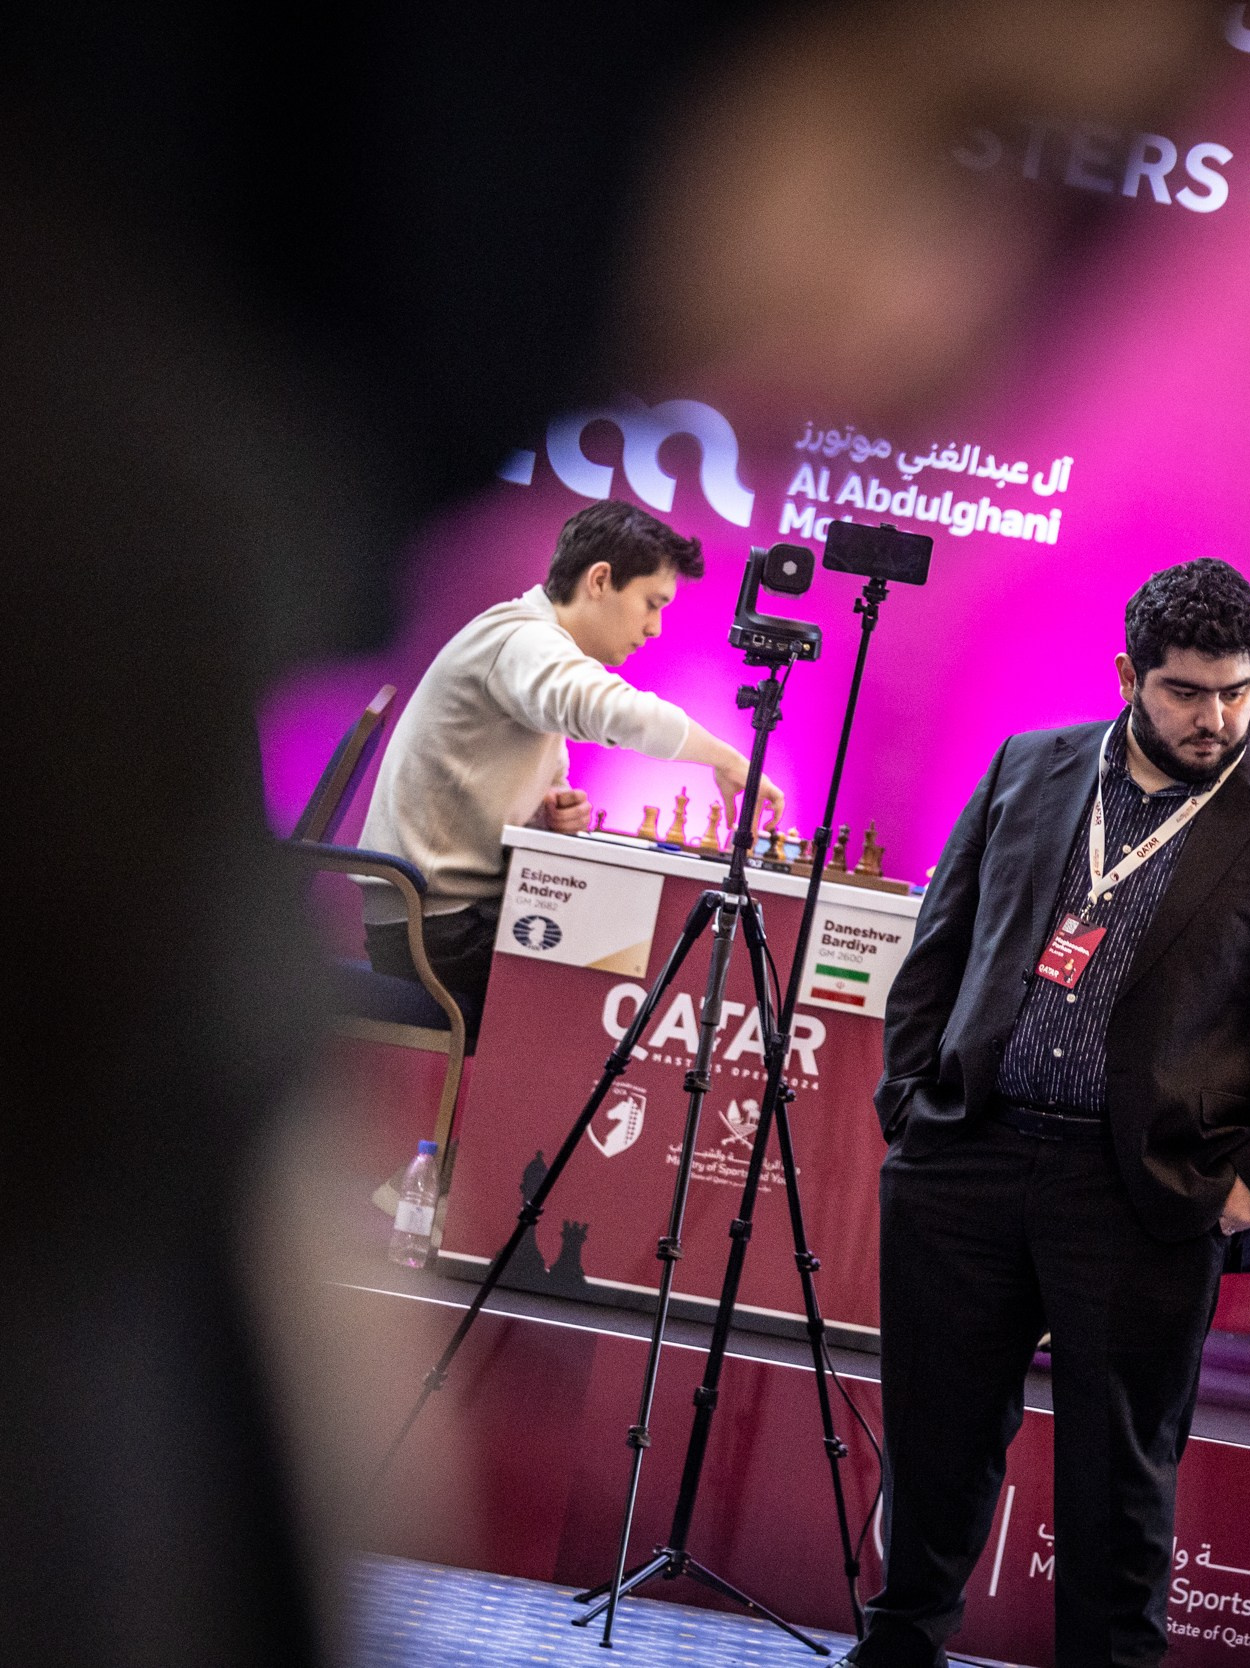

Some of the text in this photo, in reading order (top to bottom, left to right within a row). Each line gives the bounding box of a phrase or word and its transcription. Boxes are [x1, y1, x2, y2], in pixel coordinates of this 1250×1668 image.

[794, 419, 1075, 497] آل عبدالغني موتورز
[786, 461, 831, 503] Al
[834, 471, 1062, 545] Abdulghani
[1136, 837, 1161, 859] QATAR
[520, 867, 588, 890] Esipenko
[518, 882, 573, 903] Andrey
[824, 920, 902, 945] Daneshvar
[819, 948, 836, 958] GM
[821, 934, 878, 955] Bardiya
[1039, 964, 1060, 978] QATAR
[652, 1052, 722, 1073] MASTS
[1167, 1617, 1201, 1638] State
[1203, 1625, 1221, 1640] of
